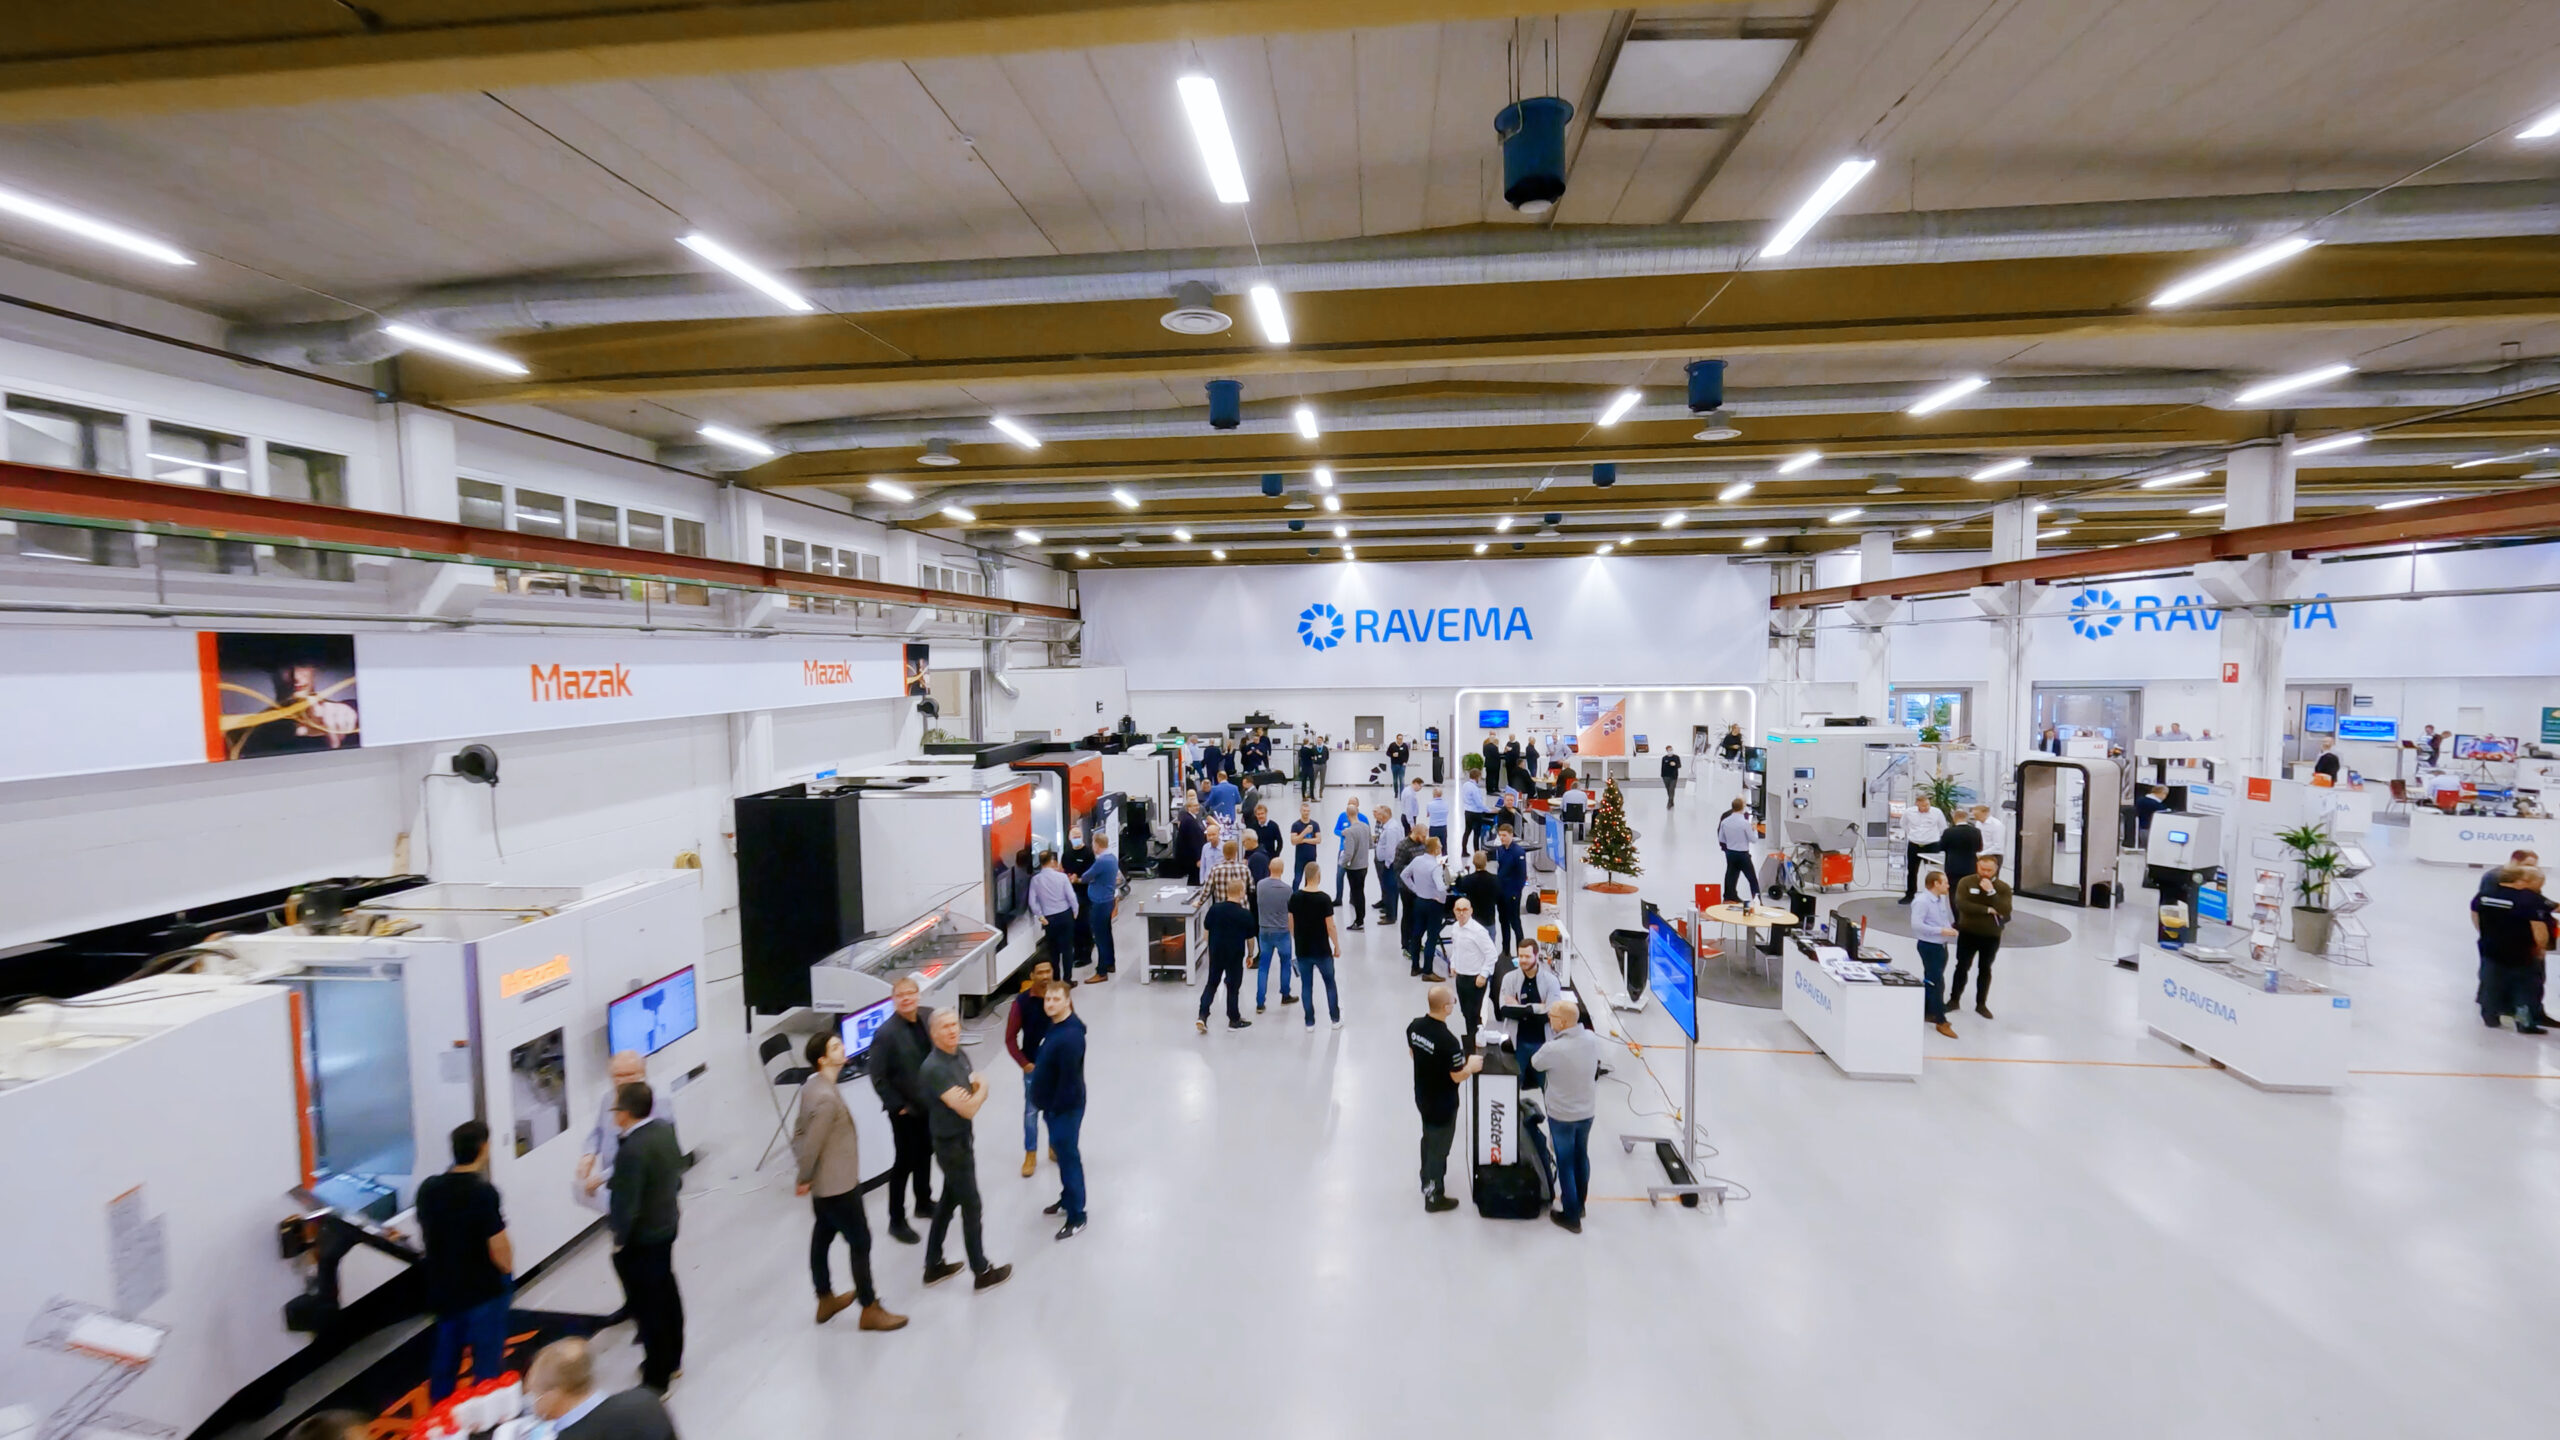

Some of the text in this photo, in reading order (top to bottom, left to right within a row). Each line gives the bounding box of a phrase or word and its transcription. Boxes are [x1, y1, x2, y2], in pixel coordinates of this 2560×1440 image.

[1355, 607, 1534, 643] RAVEMA
[2134, 592, 2338, 632] RAVA
[530, 663, 634, 702] Mazak
[804, 659, 854, 687] Mazak
[2477, 832, 2535, 842] RAVEMA
[1802, 978, 1833, 1014] RAVEMA
[2179, 986, 2238, 1025] RAVEMA
[1490, 1100, 1506, 1164] Masterca
